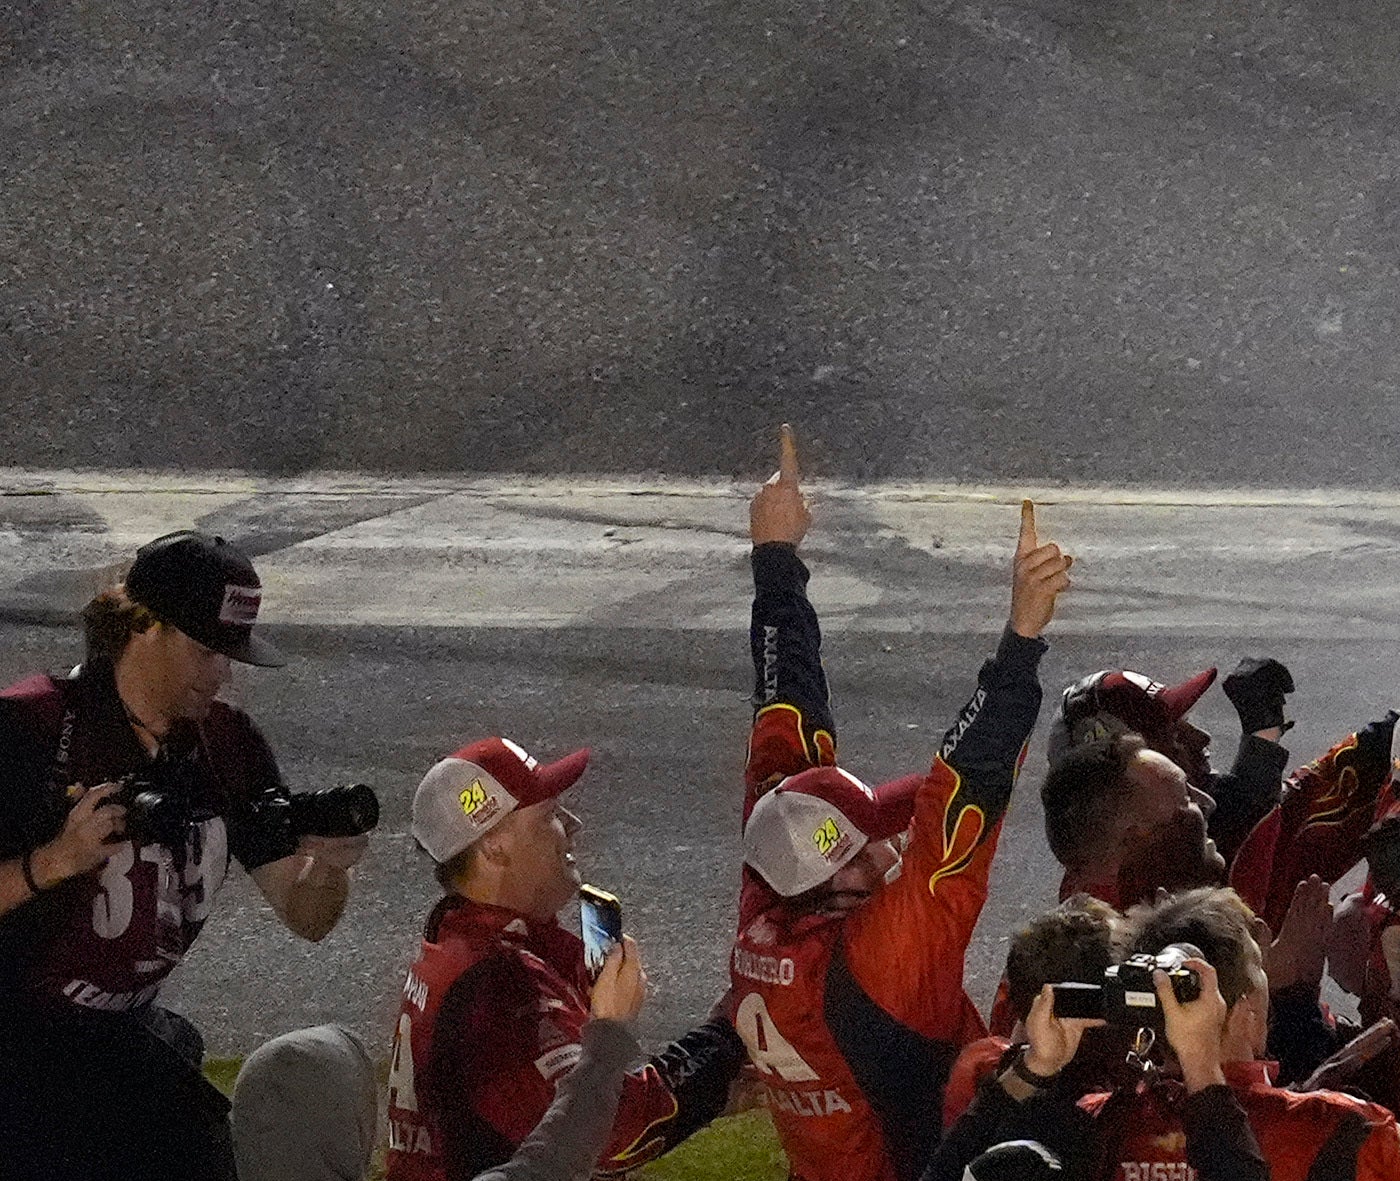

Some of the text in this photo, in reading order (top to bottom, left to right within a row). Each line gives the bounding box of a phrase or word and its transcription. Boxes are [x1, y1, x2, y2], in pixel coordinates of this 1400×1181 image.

[56, 709, 76, 762] SONY
[942, 686, 988, 758] AXALTA
[459, 777, 488, 816] 24
[812, 817, 840, 855] 24
[770, 1088, 852, 1117] ALTA
